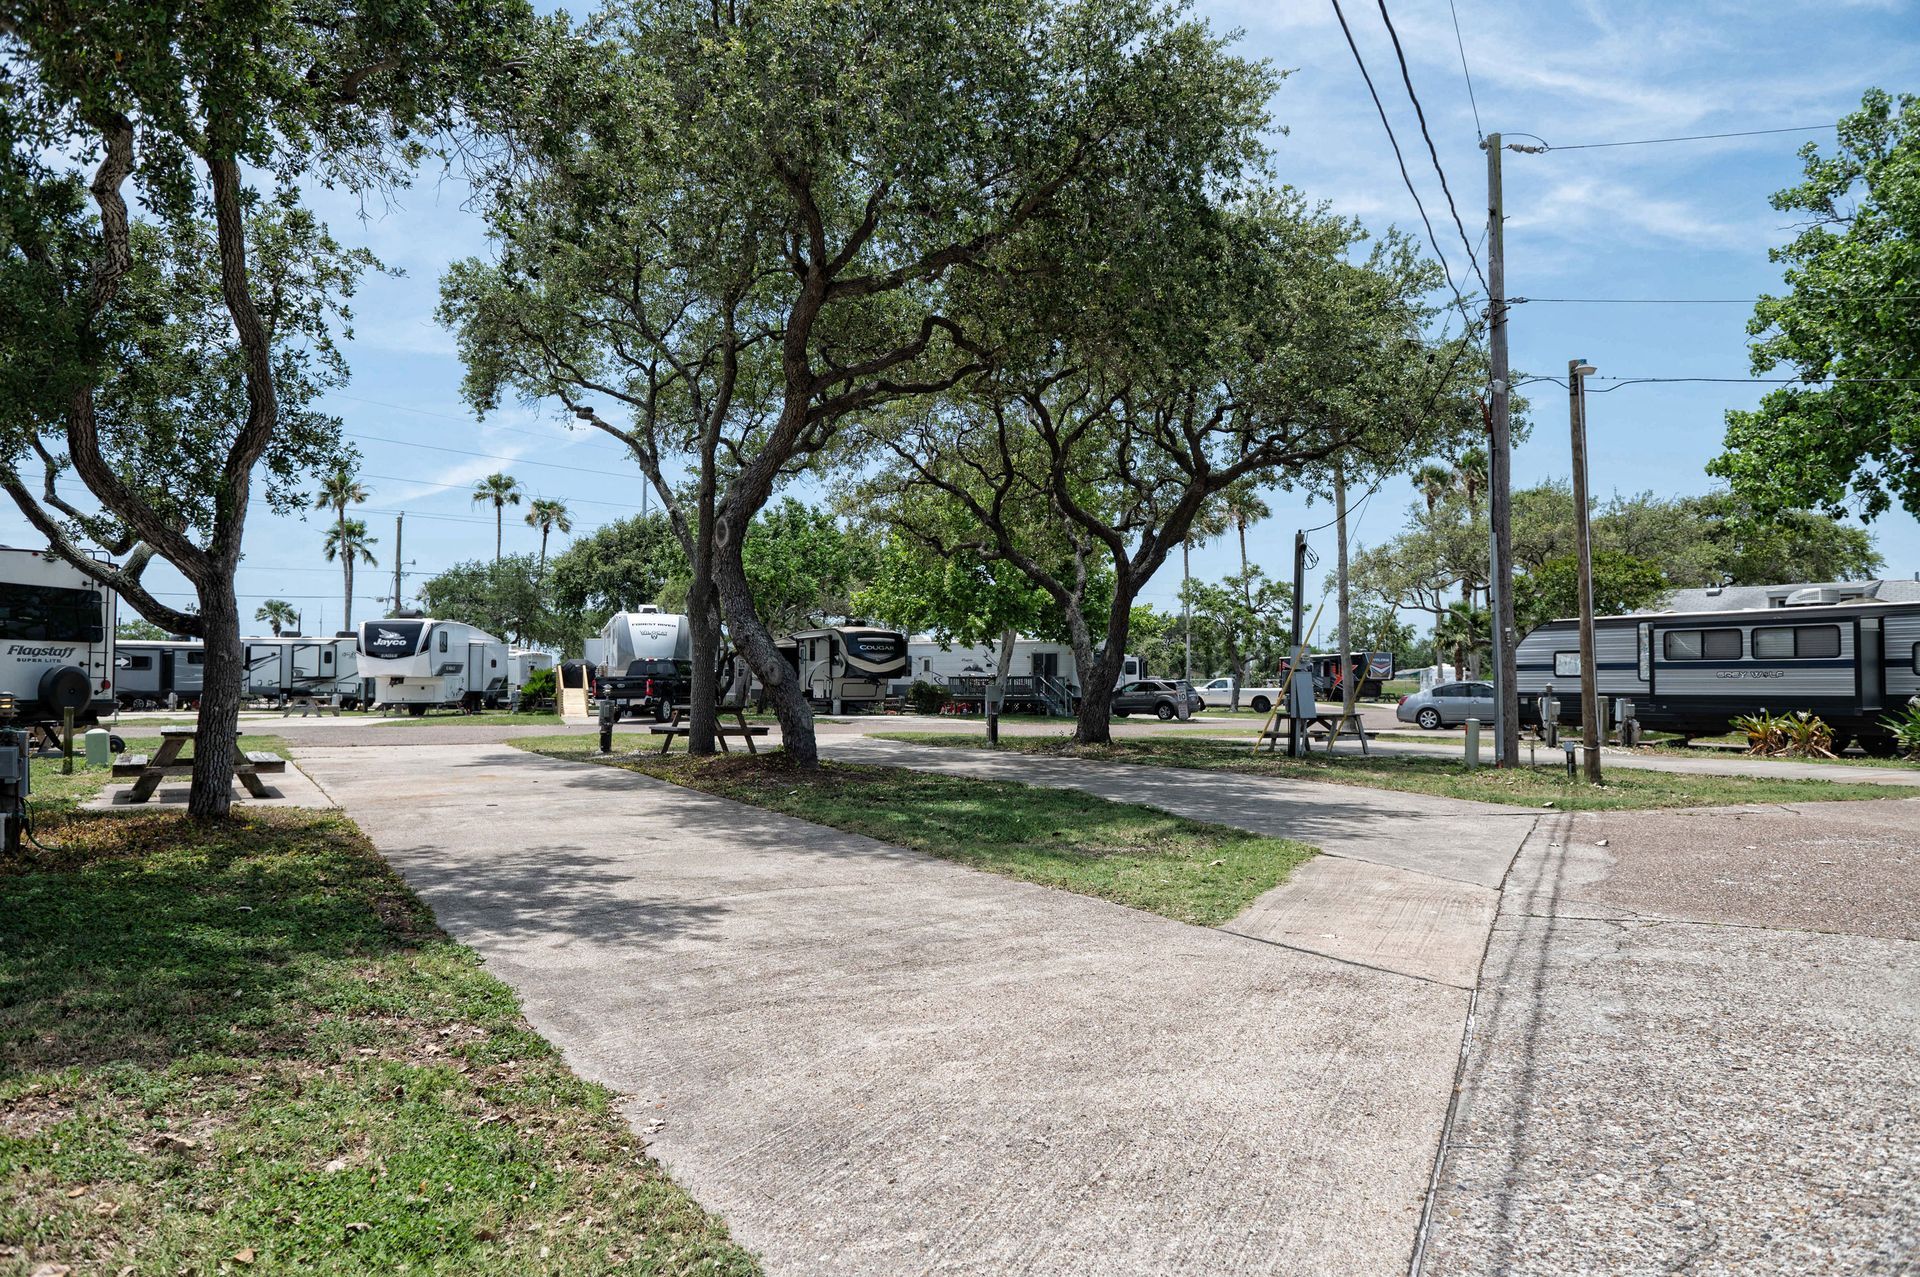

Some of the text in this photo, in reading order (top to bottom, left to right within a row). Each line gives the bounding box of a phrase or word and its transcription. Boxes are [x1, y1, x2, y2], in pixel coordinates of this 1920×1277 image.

[373, 638, 407, 647] Jayco
[7, 645, 76, 658] Flagstaff
[1716, 671, 1747, 679] GREY
